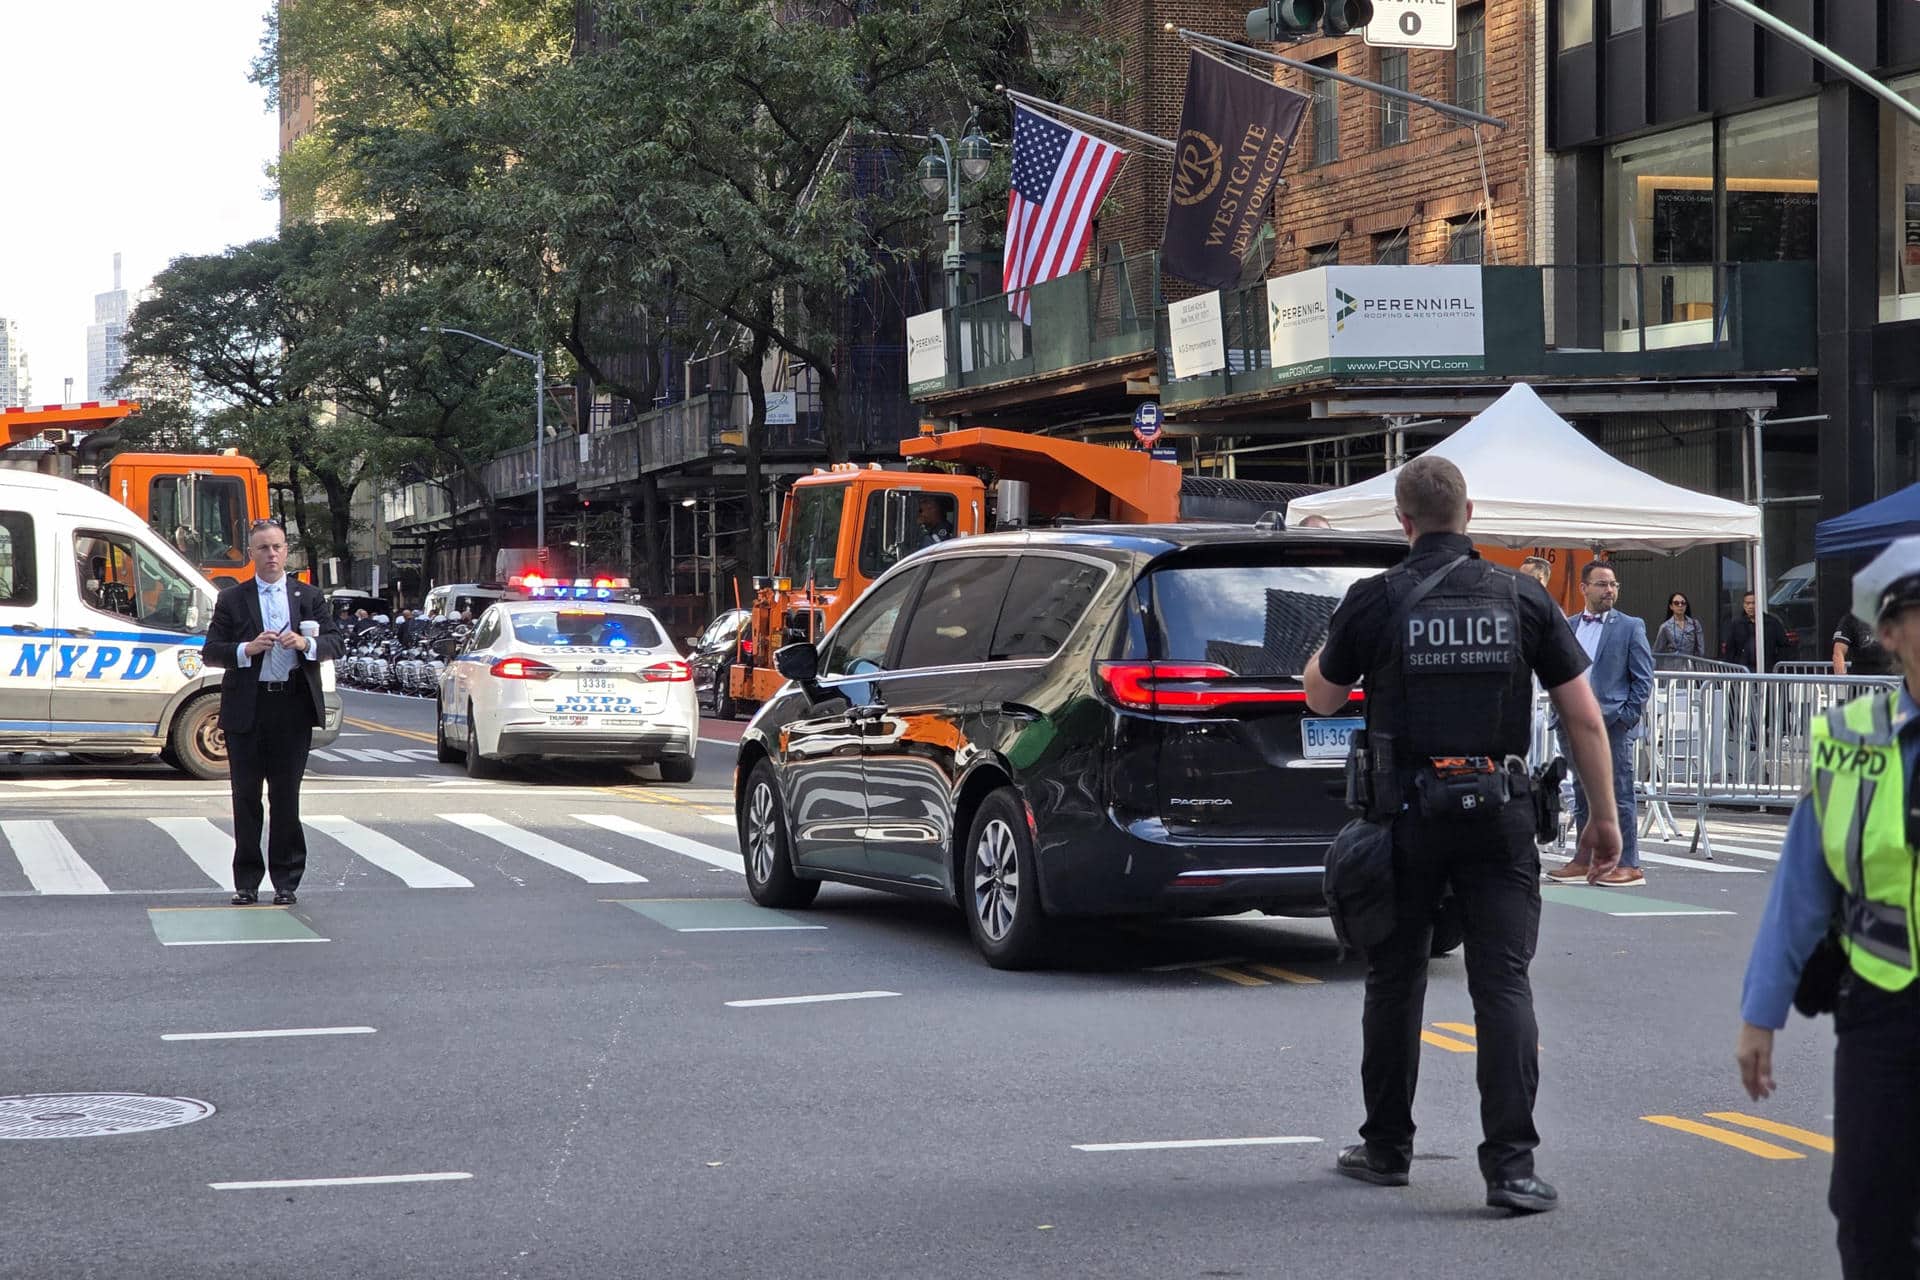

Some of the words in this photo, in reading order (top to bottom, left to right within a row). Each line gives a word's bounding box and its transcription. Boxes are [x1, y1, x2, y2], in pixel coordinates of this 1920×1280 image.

[1205, 123, 1267, 247] WESTGATE
[1229, 220, 1251, 257] NEW
[1245, 173, 1272, 219] YORK
[1264, 133, 1287, 172] CITY
[1282, 301, 1325, 320] PERENNIAL
[1364, 298, 1475, 311] PERENNIAL
[1347, 359, 1469, 370] www.PCGNYC.com
[532, 587, 611, 598] NYPD
[1408, 616, 1510, 647] POLICE
[9, 643, 157, 680] NYPD
[1410, 652, 1456, 665] SECRET
[1461, 651, 1510, 664] SERVICE
[582, 679, 606, 688] 3338
[566, 696, 632, 704] NYPD
[555, 704, 642, 714] POLICE
[1816, 740, 1887, 775] NYPD
